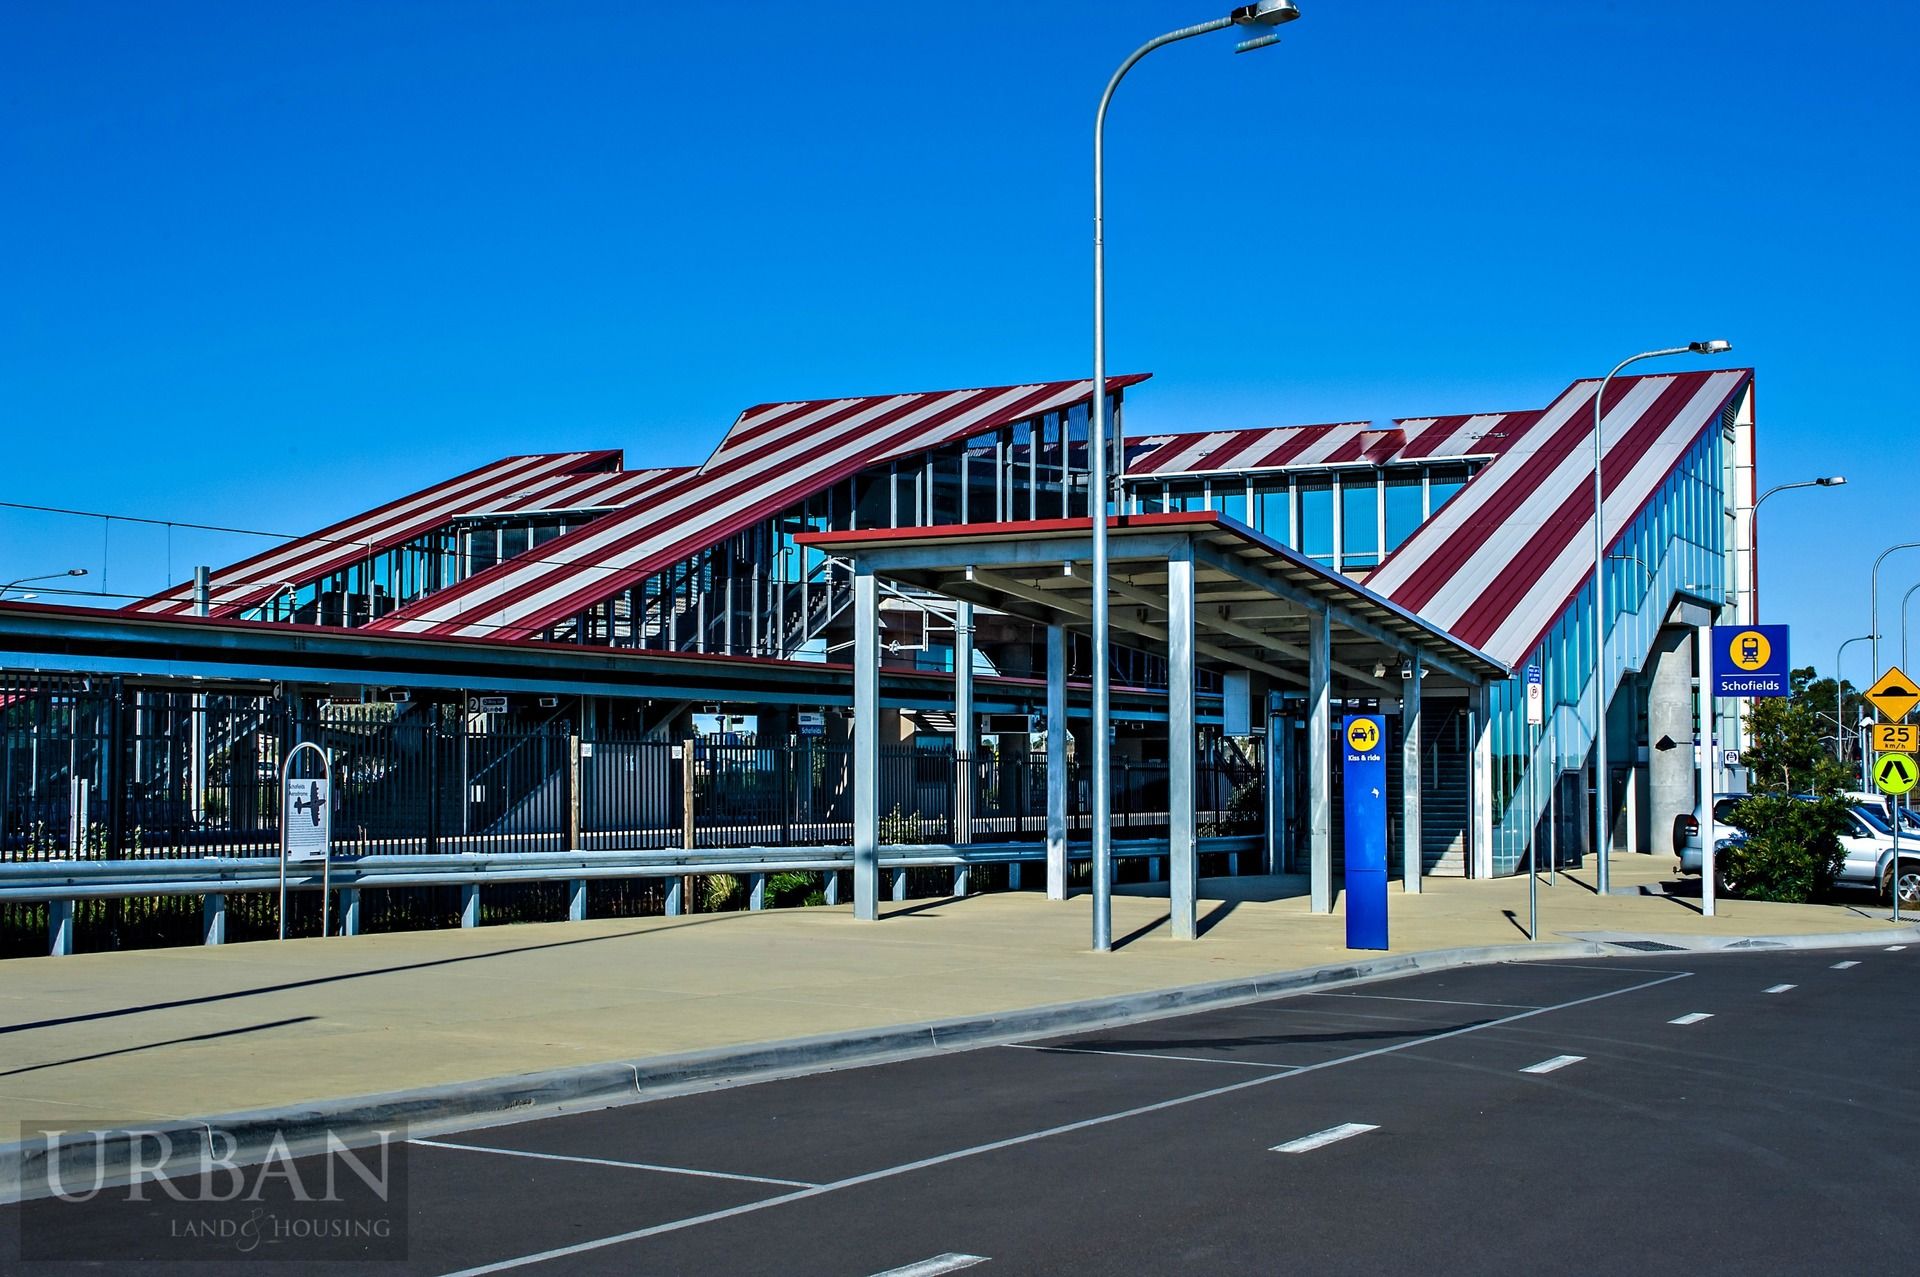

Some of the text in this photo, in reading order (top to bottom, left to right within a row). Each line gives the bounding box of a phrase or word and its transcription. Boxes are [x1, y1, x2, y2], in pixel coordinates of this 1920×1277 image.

[1721, 680, 1780, 691] Schofields
[1883, 727, 1910, 742] 25
[1348, 754, 1360, 762] Kiss
